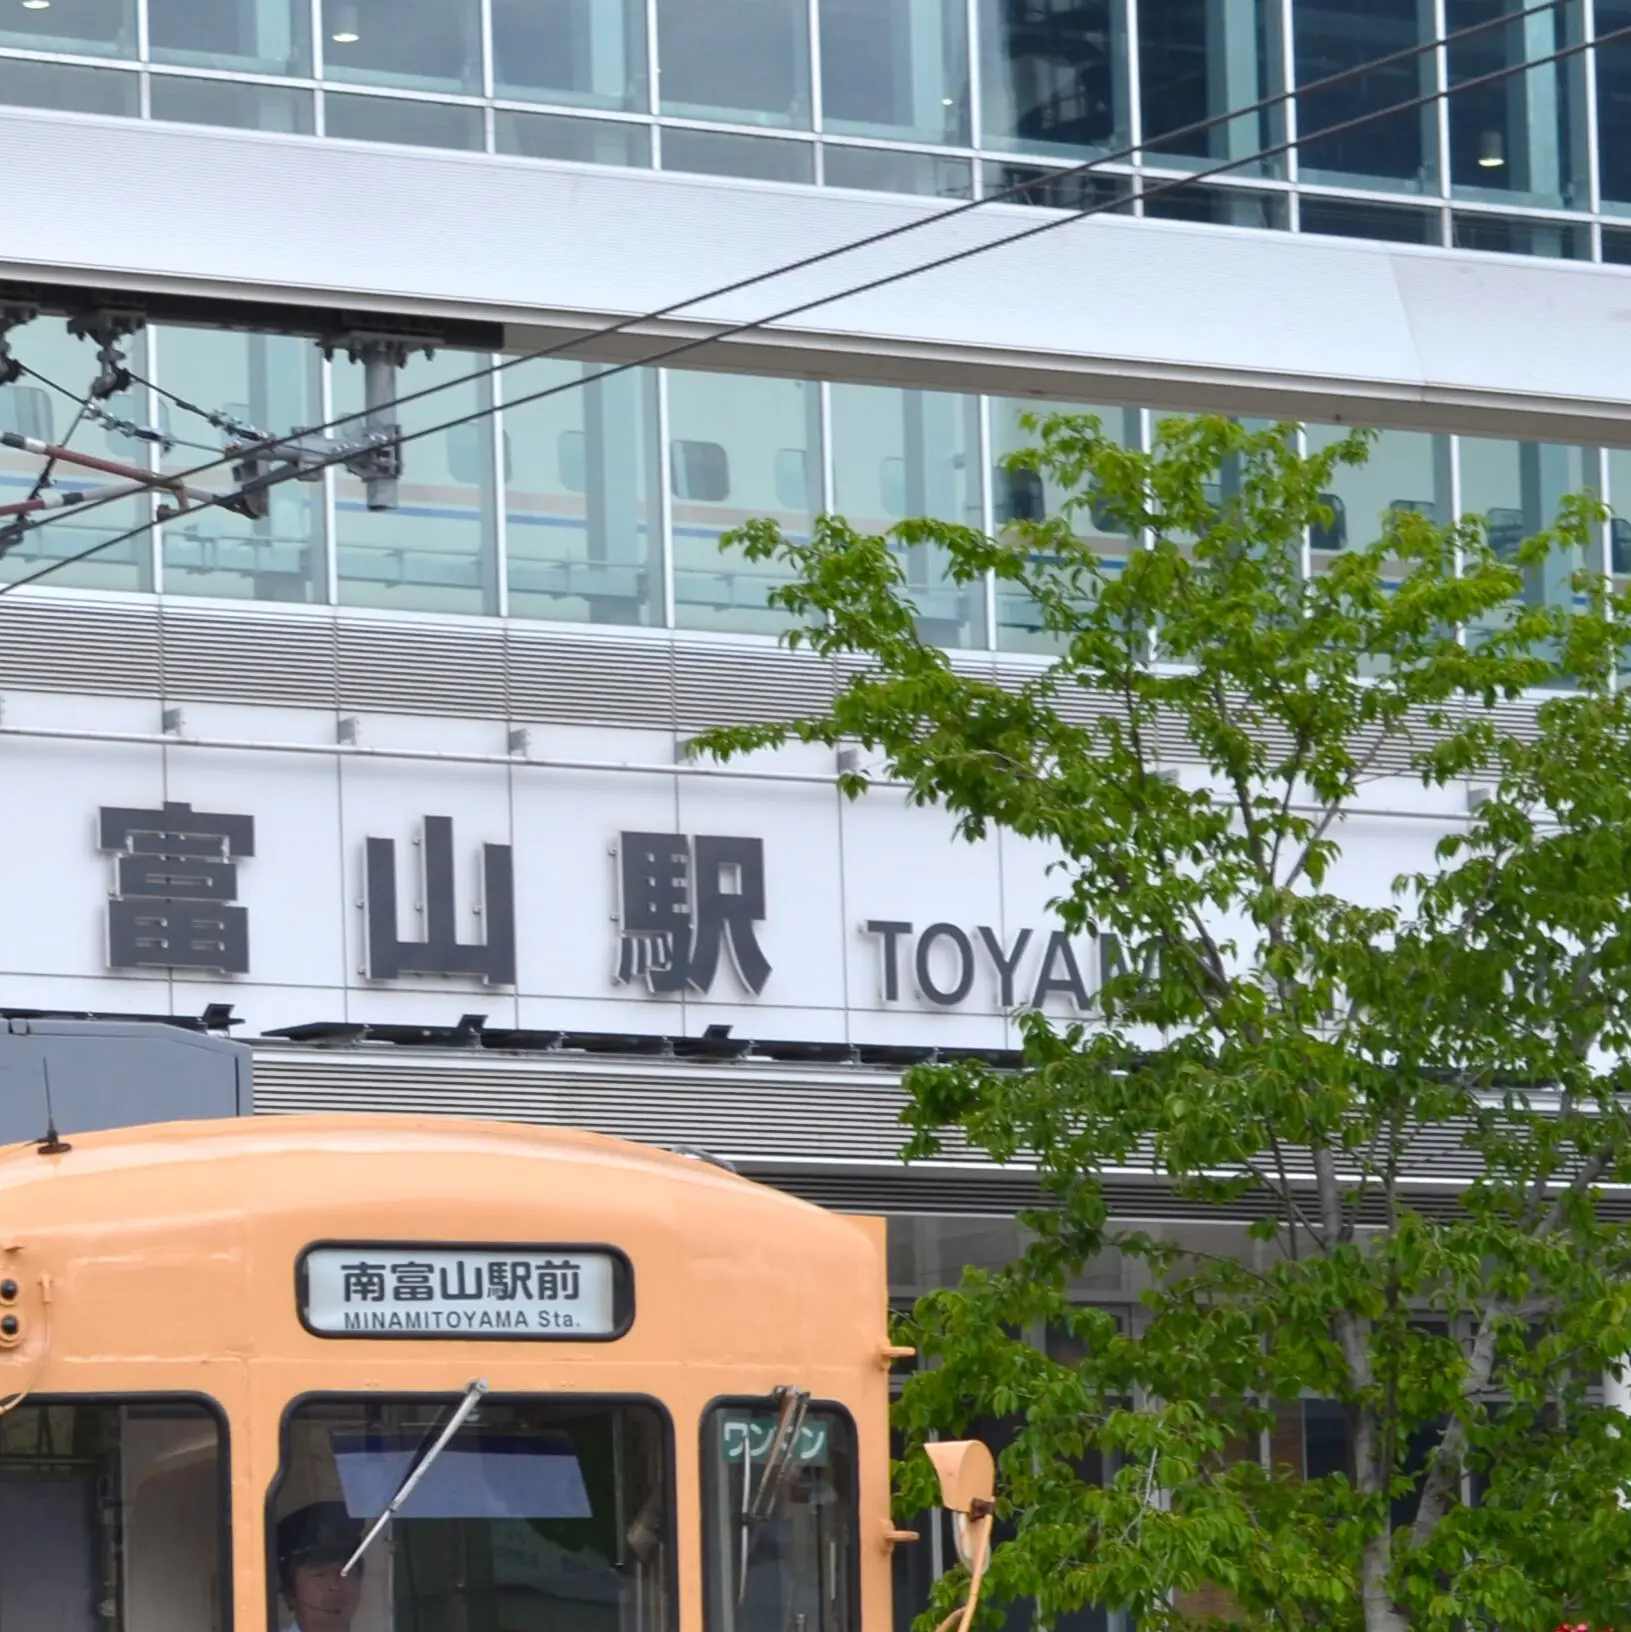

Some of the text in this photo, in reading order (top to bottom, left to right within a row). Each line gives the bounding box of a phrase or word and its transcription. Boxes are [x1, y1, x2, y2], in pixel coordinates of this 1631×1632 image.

[97, 800, 772, 995] 富山駅
[340, 1260, 581, 1302] 南富山駅前
[344, 1309, 581, 1330] MINAMITOYAMA Sta.
